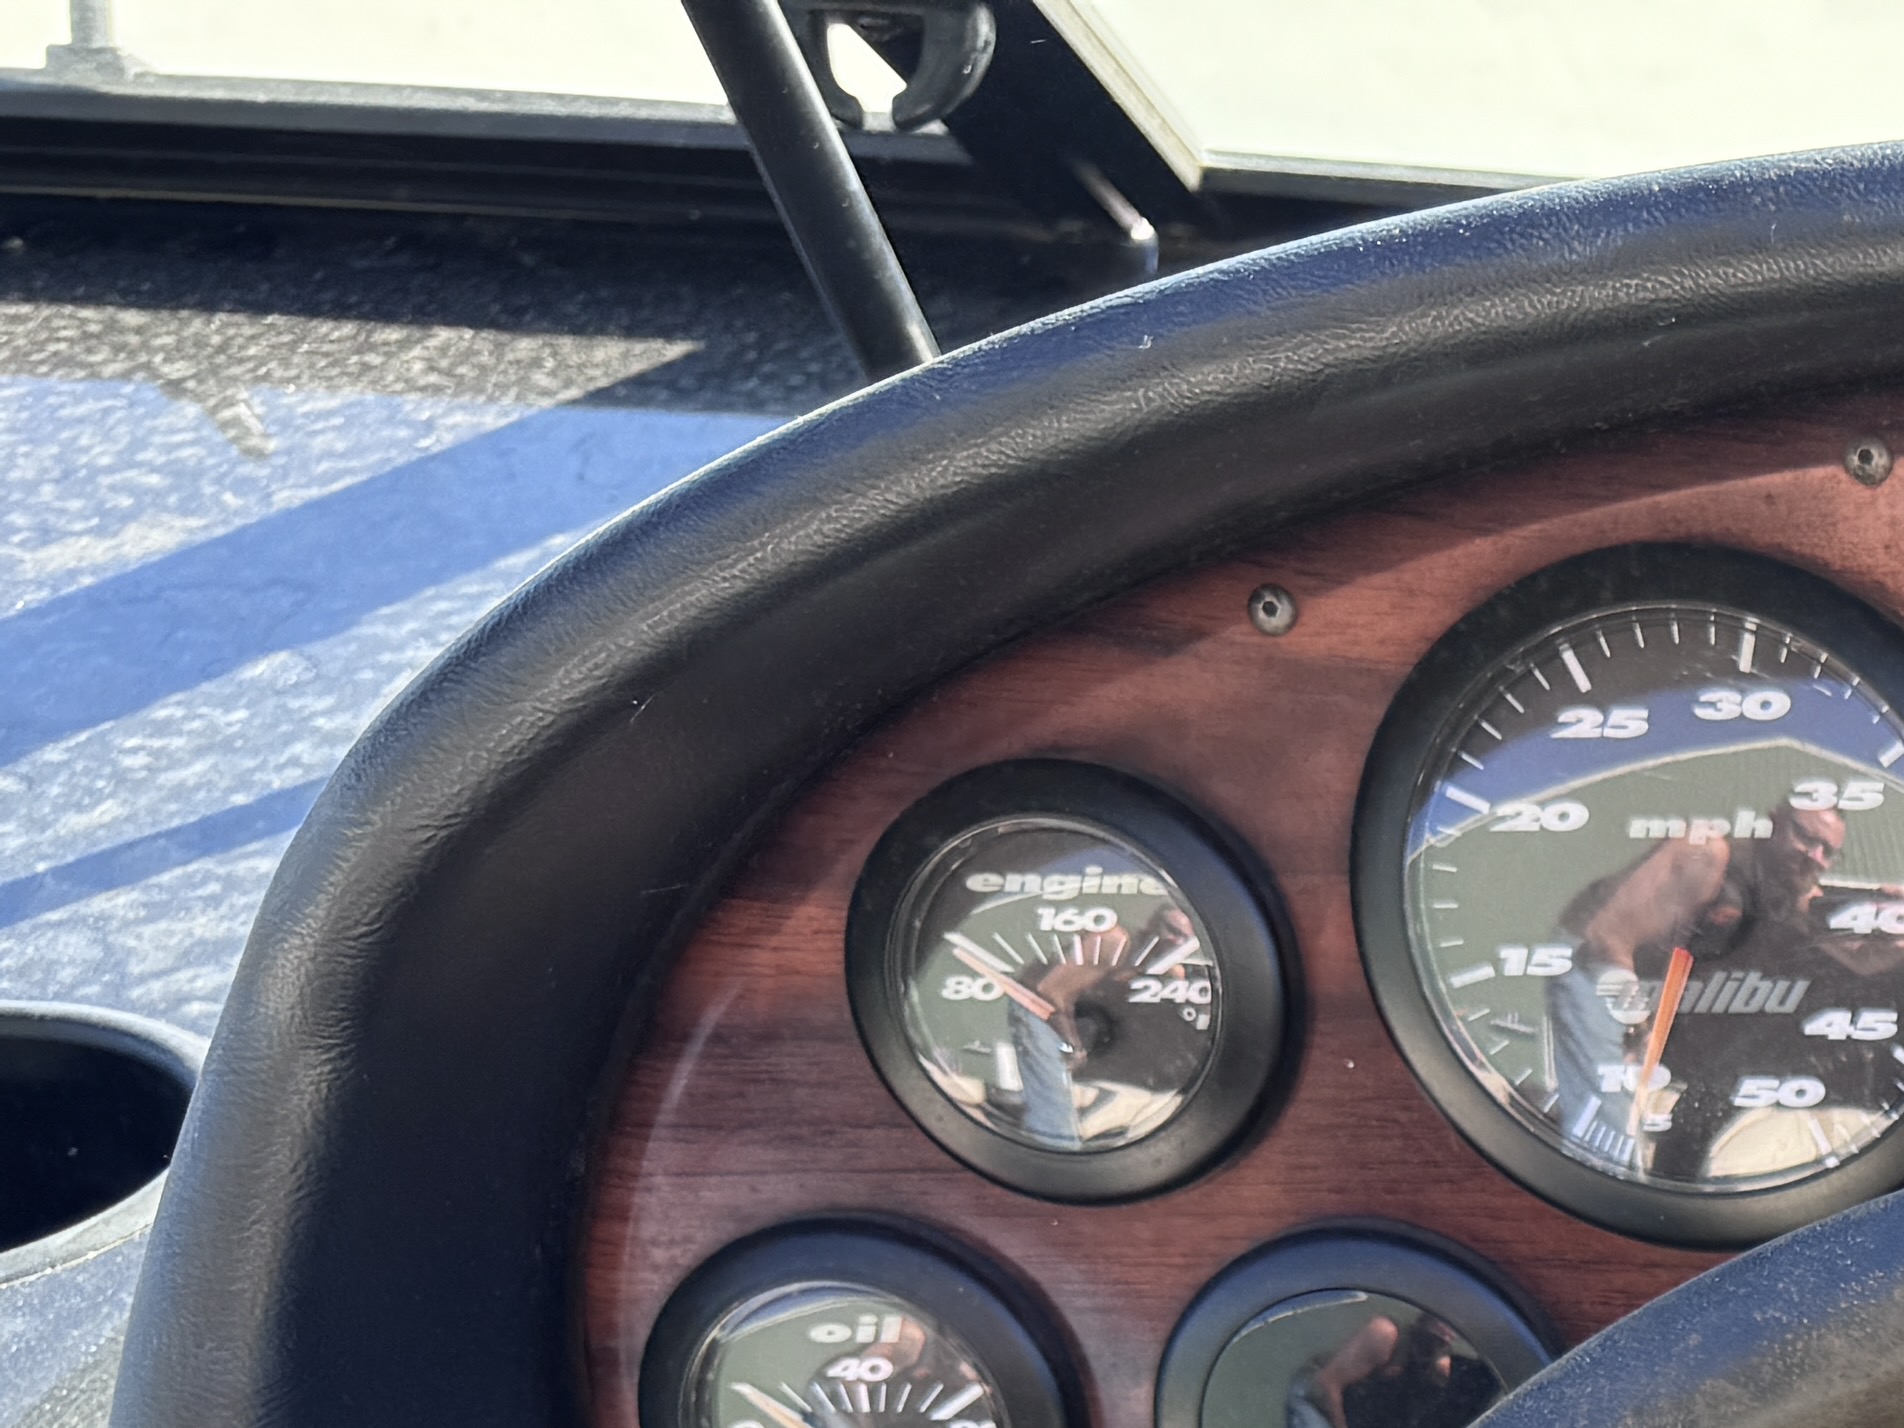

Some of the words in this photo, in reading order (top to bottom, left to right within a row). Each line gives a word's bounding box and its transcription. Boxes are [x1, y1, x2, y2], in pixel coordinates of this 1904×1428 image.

[1693, 691, 1791, 721] 30
[1551, 708, 1649, 738] 25
[1789, 782, 1884, 810] 35
[1490, 802, 1590, 832] 20
[1628, 811, 1773, 845] mph
[967, 867, 1168, 895] engine
[1036, 908, 1117, 931] 160
[1499, 947, 1573, 976] 15
[942, 977, 1002, 1000] 80
[1129, 979, 1211, 1002] 240
[1804, 1010, 1898, 1039] 45
[1599, 1064, 1671, 1092] 10
[1734, 1077, 1826, 1107] 50
[1643, 1113, 1673, 1131] 5
[808, 1315, 902, 1343] oil
[827, 1357, 894, 1381] 40
